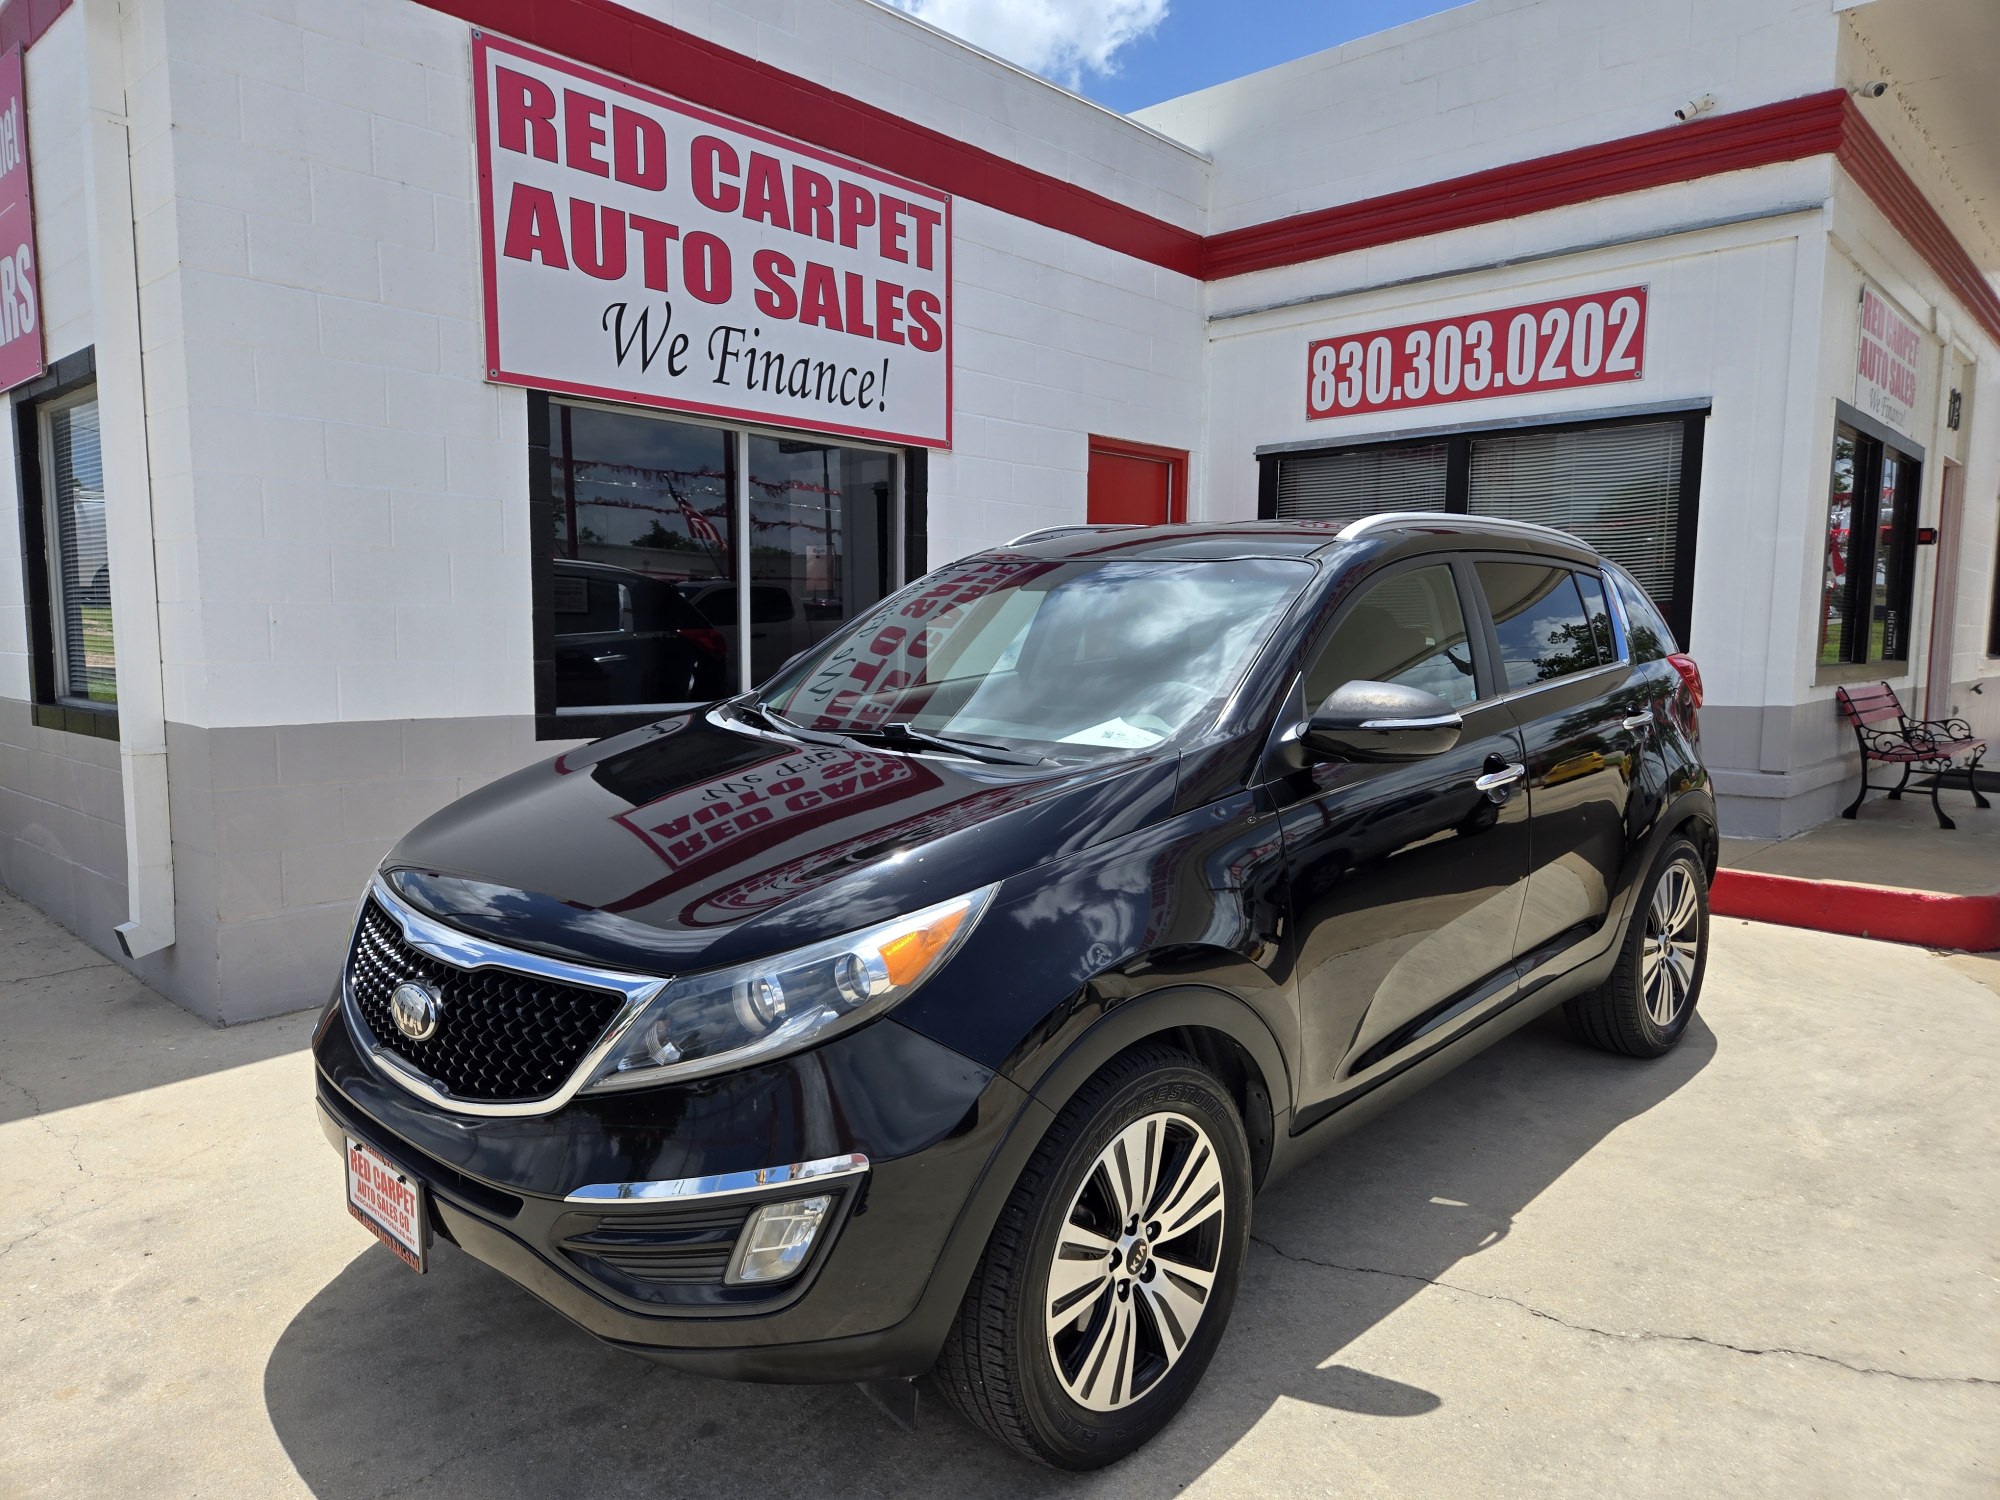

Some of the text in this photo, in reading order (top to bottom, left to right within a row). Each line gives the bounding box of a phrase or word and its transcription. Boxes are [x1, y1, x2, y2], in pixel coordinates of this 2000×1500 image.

[495, 64, 942, 271] RED CARPET
[503, 181, 943, 353] AUTO SALES
[602, 301, 890, 413] We Finance!
[1310, 296, 1641, 412] 830.303.0202
[1862, 290, 1921, 368] RED CARPET
[1858, 336, 1916, 409] AUTO SALES
[1083, 1084, 1228, 1164] BRIDGESTONE
[350, 1147, 416, 1218] RED CARPET
[357, 1178, 412, 1235] AUTO SALES CO.
[1130, 1245, 1147, 1272] KIA
